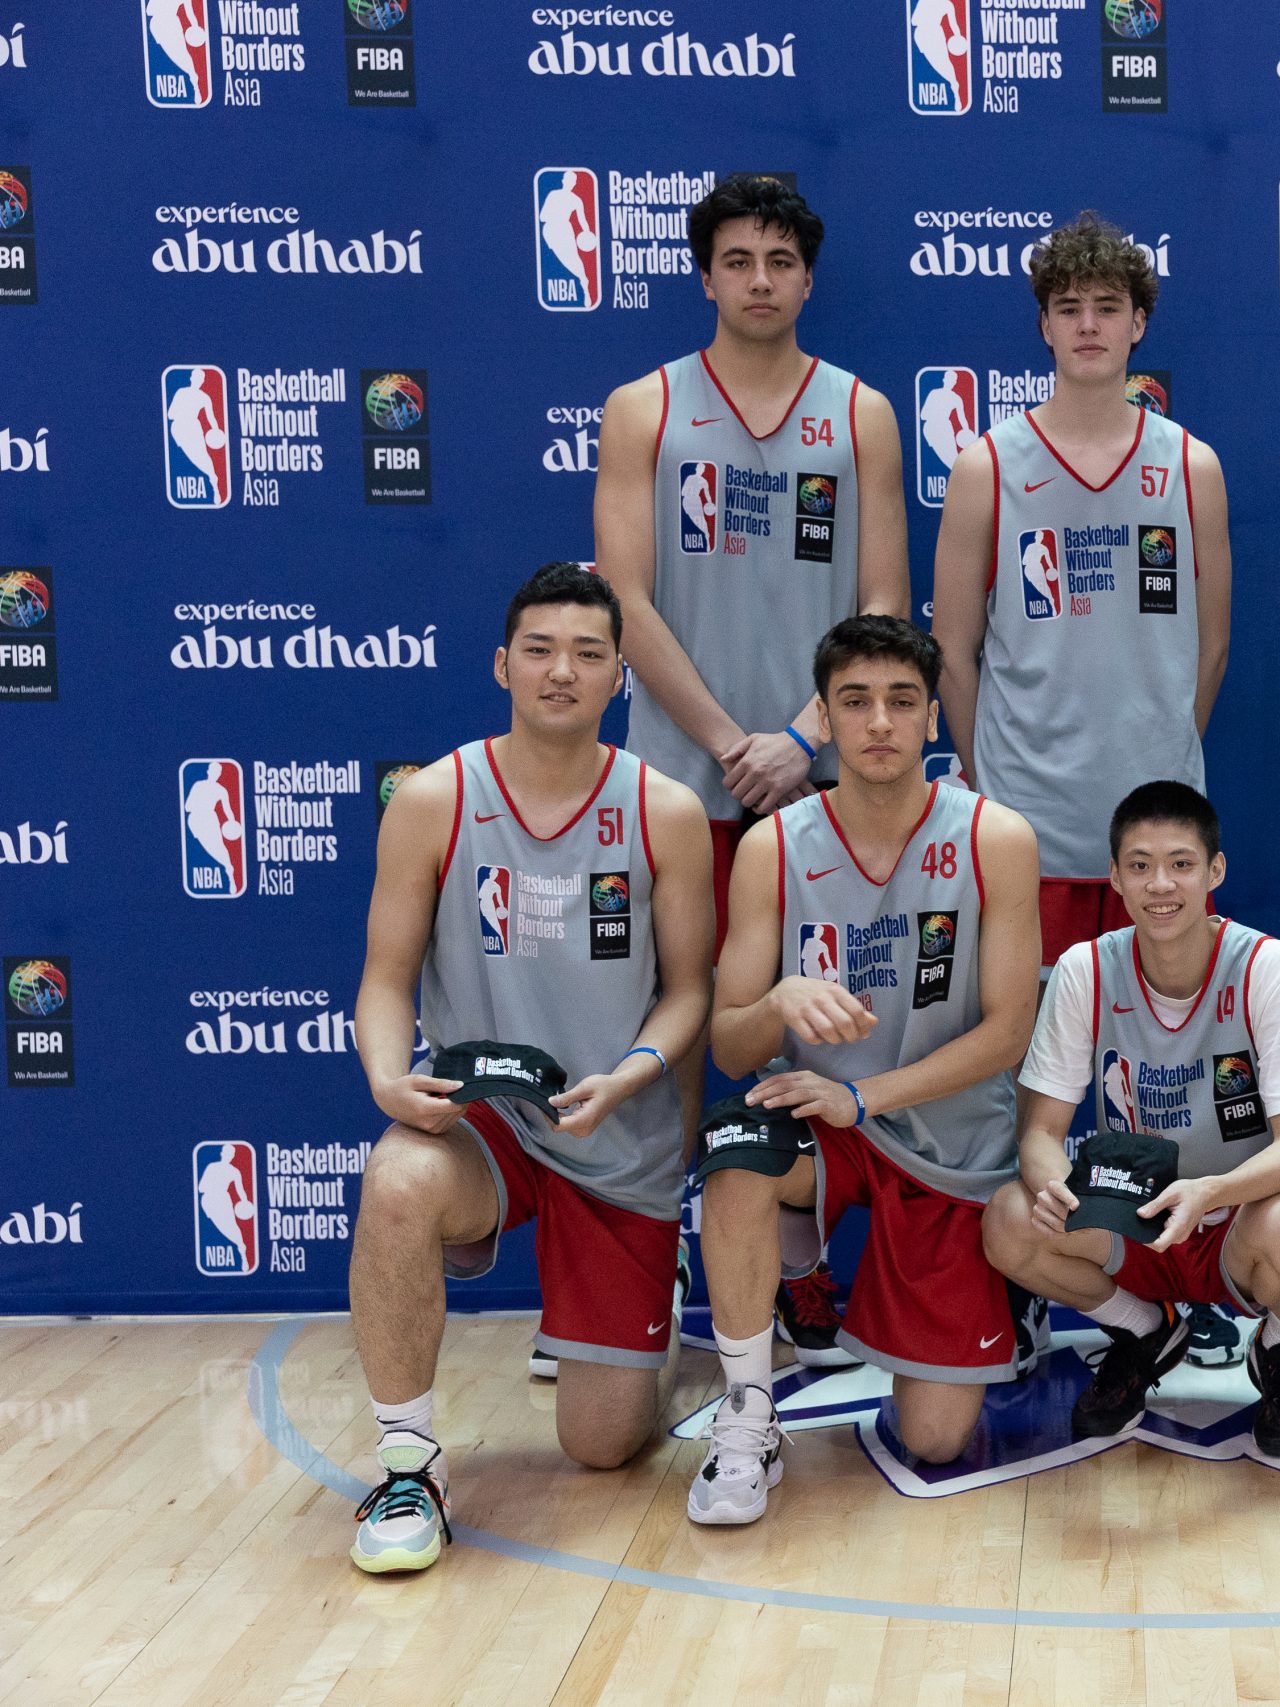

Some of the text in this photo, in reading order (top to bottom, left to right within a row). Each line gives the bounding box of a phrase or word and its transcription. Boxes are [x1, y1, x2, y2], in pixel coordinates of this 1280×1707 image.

[219, 0, 299, 35] Without
[221, 36, 304, 71] Borders
[357, 48, 403, 70] FIBA
[529, 32, 631, 75] abu
[1113, 56, 1156, 77] FIBA
[157, 75, 187, 97] NBA
[225, 72, 260, 106] Asia
[354, 89, 409, 98] We Are Basketball
[919, 83, 947, 104] NBA
[610, 206, 688, 239] Without
[153, 229, 256, 272] abu
[612, 241, 692, 274] Borders
[910, 234, 1010, 276] abu
[548, 280, 577, 300] NBA
[614, 276, 648, 308] Asia
[238, 369, 345, 401] Basketball
[239, 404, 318, 436] Without
[801, 417, 834, 447] 54
[241, 438, 322, 471] Borders
[375, 448, 419, 469] FIBA
[177, 477, 206, 498] NBA
[244, 473, 278, 505] Asia
[726, 464, 787, 493] Basketball
[1141, 465, 1169, 497] 57
[371, 488, 425, 497] We Are Basketball
[725, 486, 769, 514] Without
[724, 510, 771, 537] Borders
[802, 523, 830, 541] FIBA
[684, 533, 704, 549] NBA
[724, 533, 746, 556] Asia
[1064, 524, 1129, 549] Basketball
[1065, 547, 1112, 571] Without
[1067, 570, 1115, 594] Borders
[1145, 576, 1171, 592] FIBA
[1029, 600, 1048, 616] NBA
[1070, 594, 1092, 616] Asia
[0, 645, 45, 666] FIBA
[171, 626, 273, 668] abu
[597, 807, 624, 846] 51
[921, 841, 957, 879] 48
[517, 870, 582, 896] Basketball
[517, 891, 564, 918] Without
[517, 914, 565, 939] Borders
[597, 922, 626, 937] FIBA
[483, 935, 501, 951] NBA
[517, 936, 538, 958] Asia
[848, 965, 898, 995] Borders
[921, 963, 945, 985] FIBA
[18, 1032, 62, 1053] FIBA
[186, 1013, 287, 1053] abu
[14, 1071, 68, 1080] We Are Basketball
[1138, 1058, 1205, 1087] Basketball
[1137, 1085, 1188, 1109] Without
[1140, 1107, 1192, 1130] Borders
[1223, 1101, 1256, 1121] FIBA
[1108, 1116, 1125, 1133] NBA
[268, 1176, 344, 1207] Without
[269, 1209, 348, 1239] Borders
[206, 1246, 234, 1266] NBA
[271, 1242, 305, 1271] Asia
